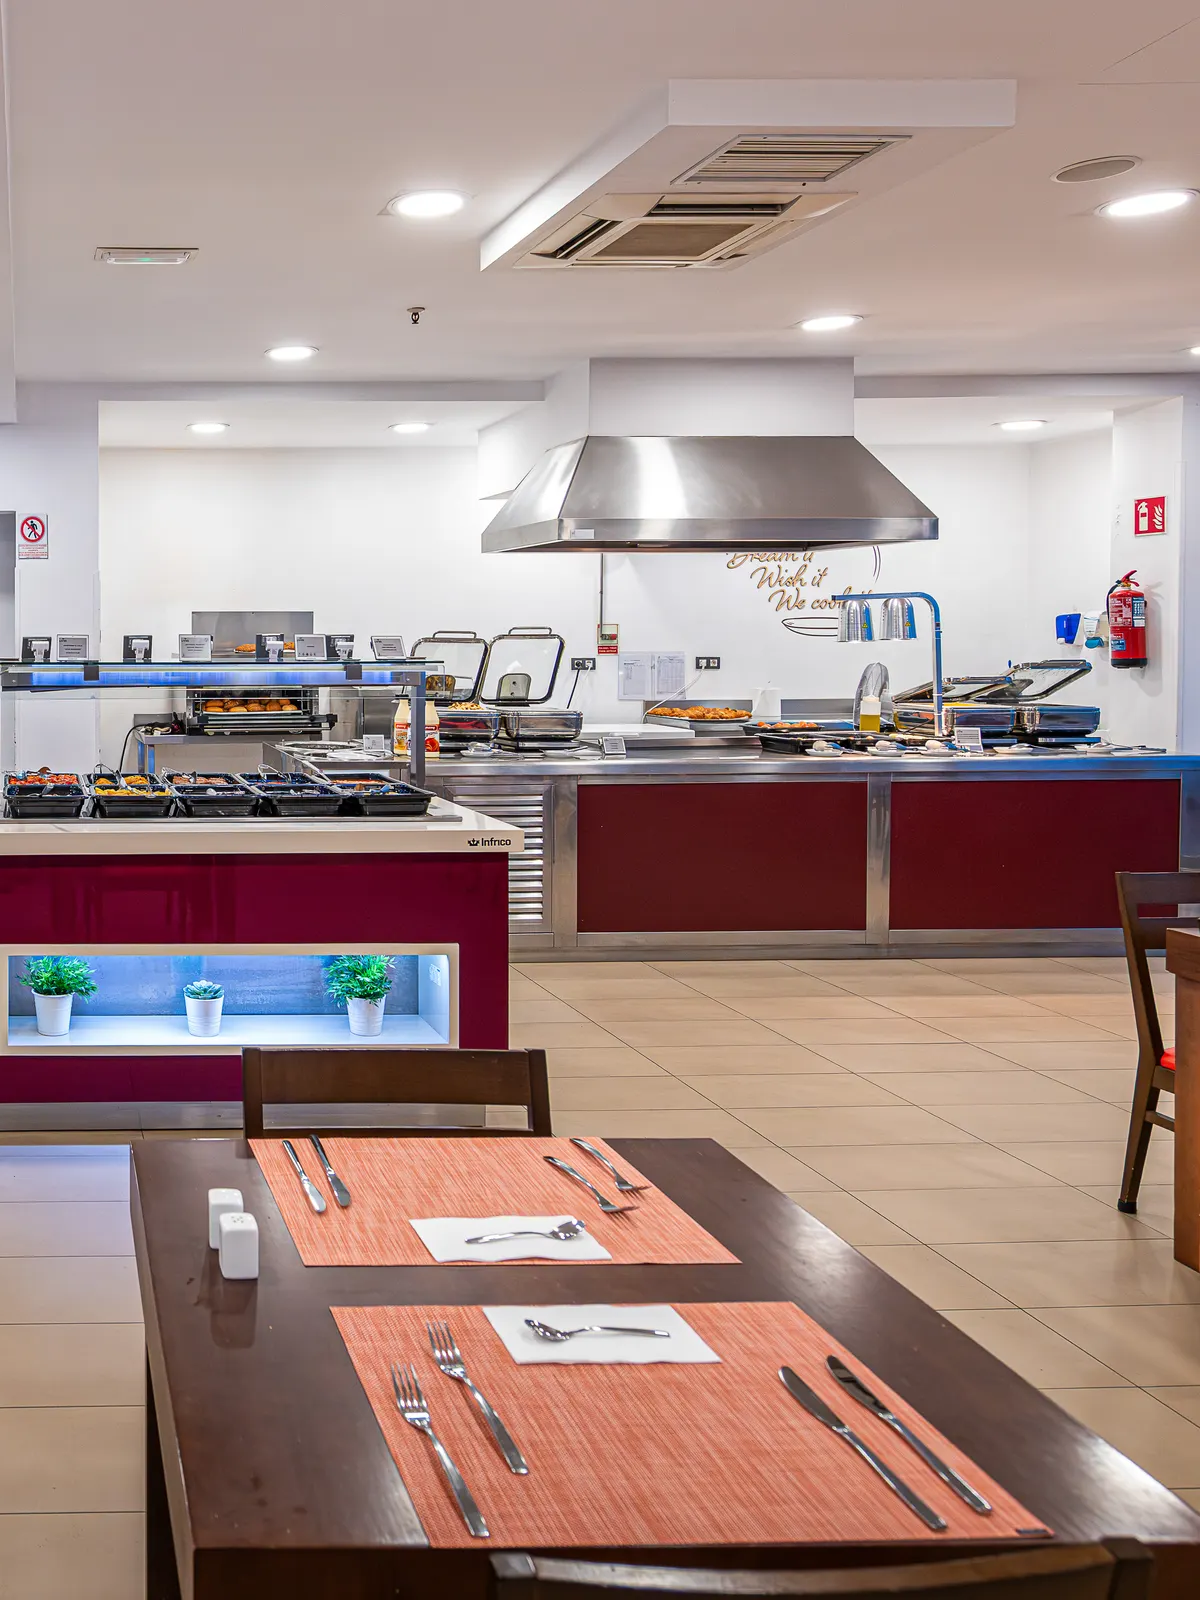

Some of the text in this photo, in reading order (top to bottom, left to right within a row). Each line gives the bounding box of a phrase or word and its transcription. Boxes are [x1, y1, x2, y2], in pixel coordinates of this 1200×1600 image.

[750, 563, 829, 589] Wish it
[768, 587, 806, 612] We
[481, 837, 512, 847] Infrico
